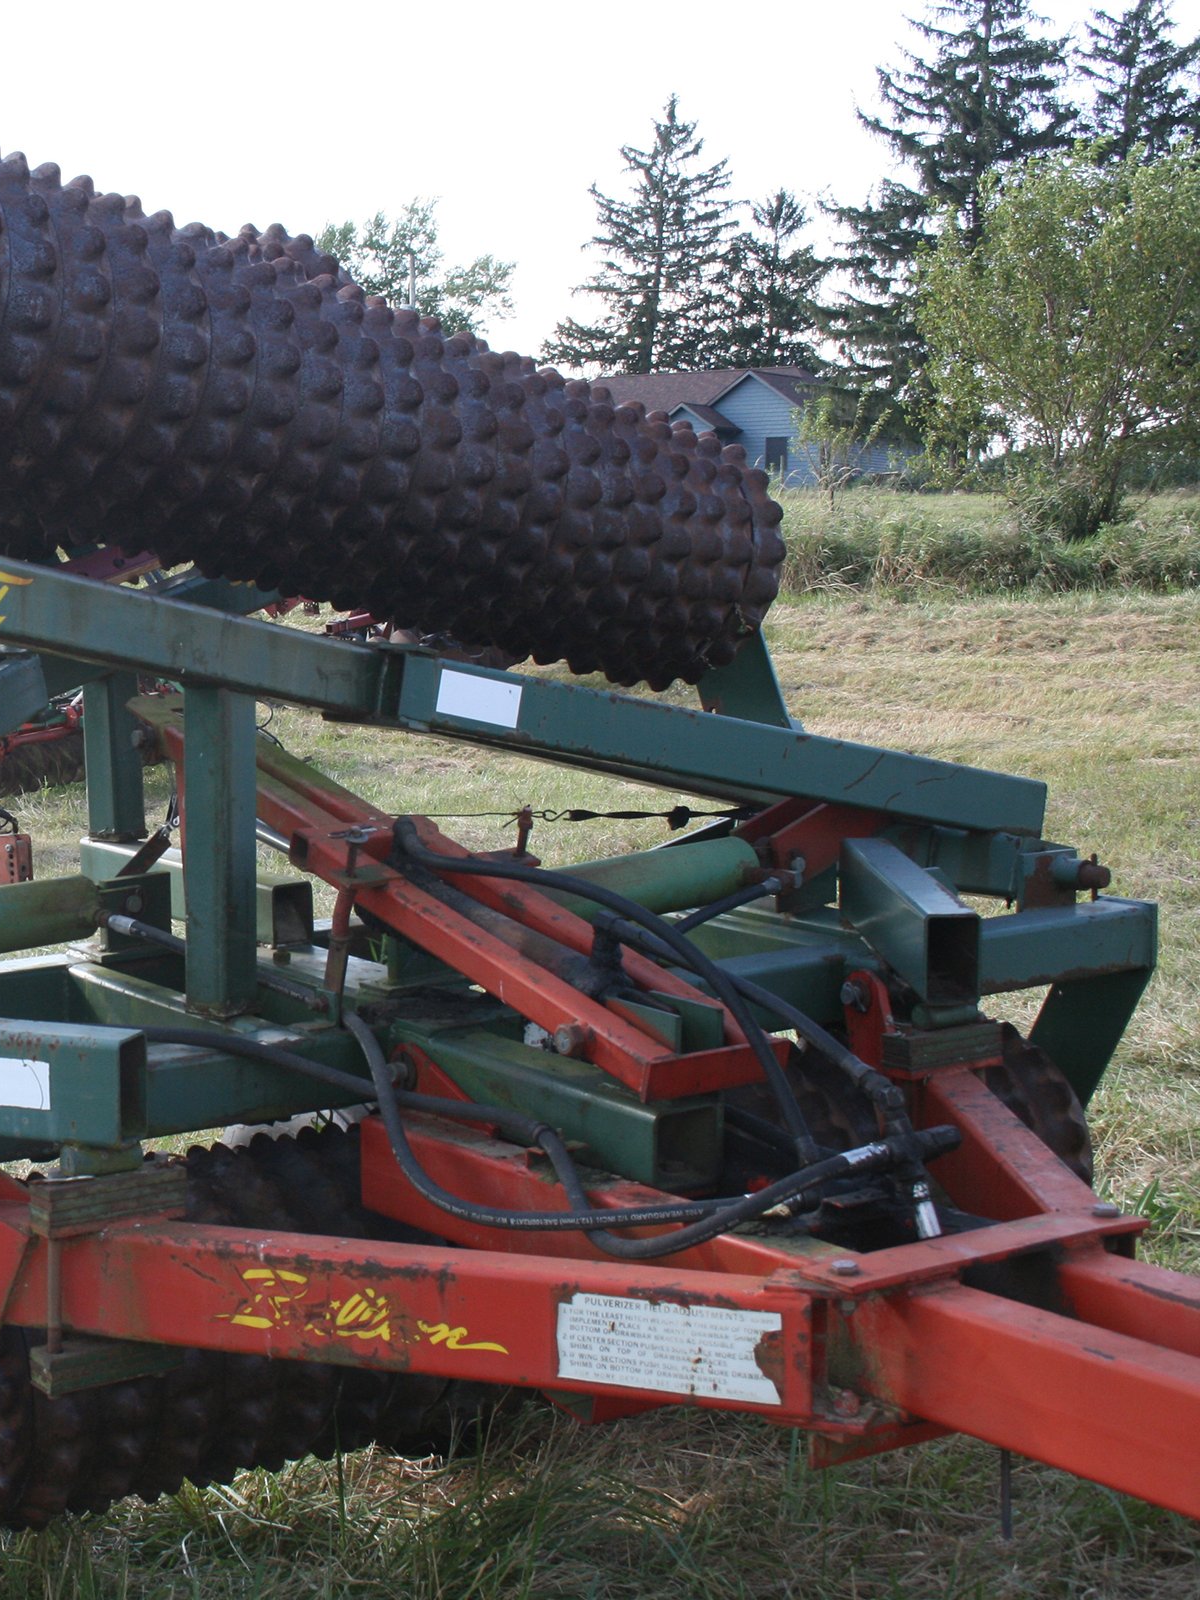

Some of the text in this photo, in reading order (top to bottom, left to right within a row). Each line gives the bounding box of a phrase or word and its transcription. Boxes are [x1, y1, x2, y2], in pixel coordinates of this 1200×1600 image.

[585, 1297, 640, 1310] PULVERIZER
[645, 1304, 669, 1313] FIELD
[674, 1307, 744, 1321] ADJUSTMENTS
[570, 1325, 600, 1333] BOTTOM
[577, 1335, 605, 1344] CENTER
[608, 1339, 638, 1347] SECTION
[601, 1356, 636, 1365] SECTIONS
[610, 1365, 641, 1373] BOTTOM
